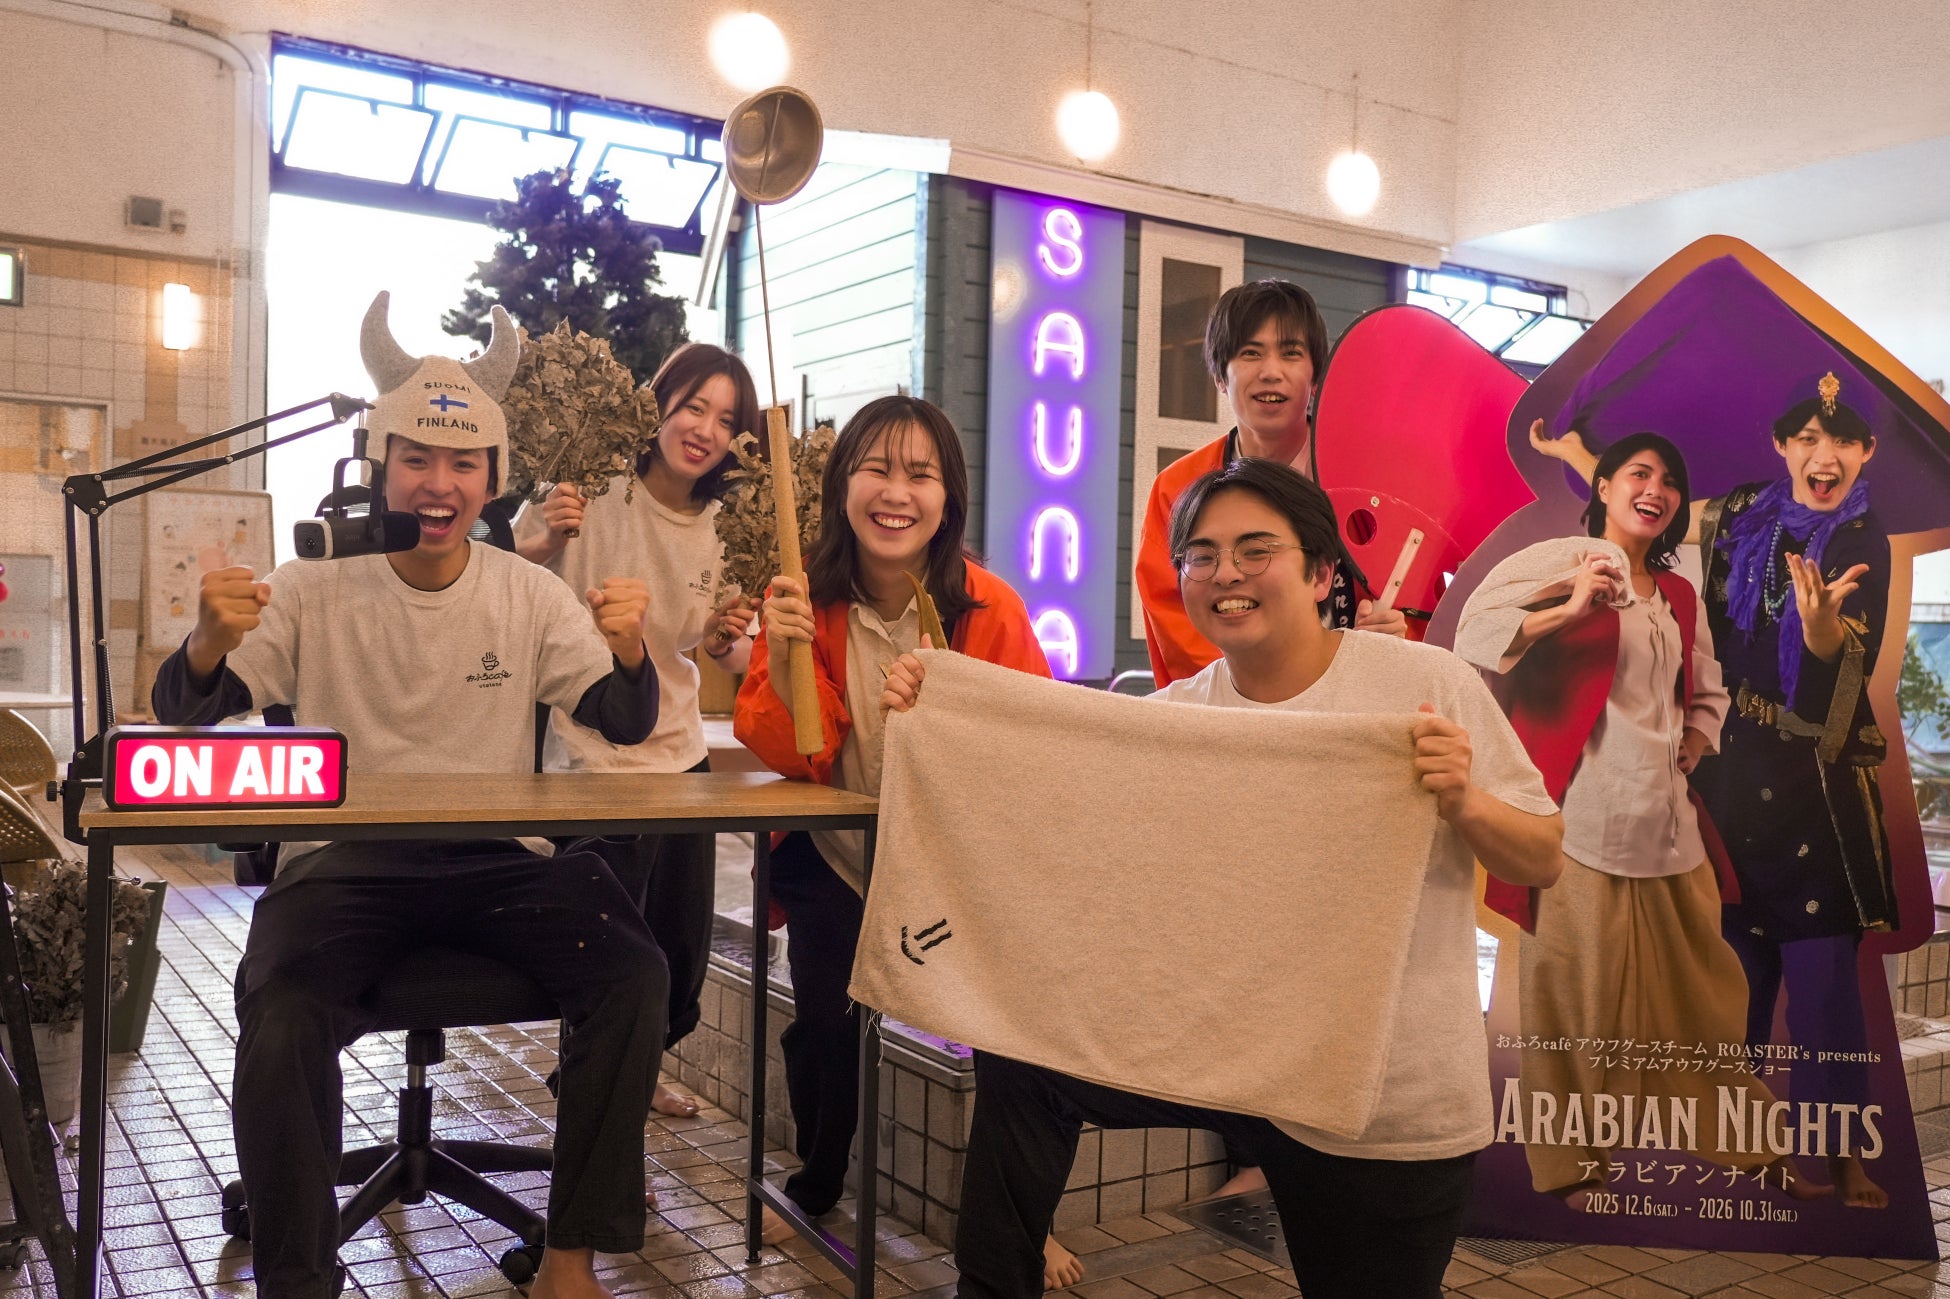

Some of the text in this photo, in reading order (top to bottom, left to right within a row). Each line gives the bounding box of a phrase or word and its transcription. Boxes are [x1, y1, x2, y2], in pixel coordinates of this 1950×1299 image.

[424, 381, 471, 393] SUOMI
[417, 417, 478, 433] FINLAND
[130, 744, 326, 797] ON AIR
[1496, 1034, 1881, 1063] おふろcafé アウフグースチーム ROASTER's presents
[1588, 1055, 1792, 1075] プレミアムアウフグースショー
[1495, 1077, 1884, 1160] ARABIAN NIGHTS
[1577, 1159, 1796, 1191] アラビアンナイト
[1585, 1192, 1619, 1214] 2025
[1698, 1197, 1733, 1220] 2026
